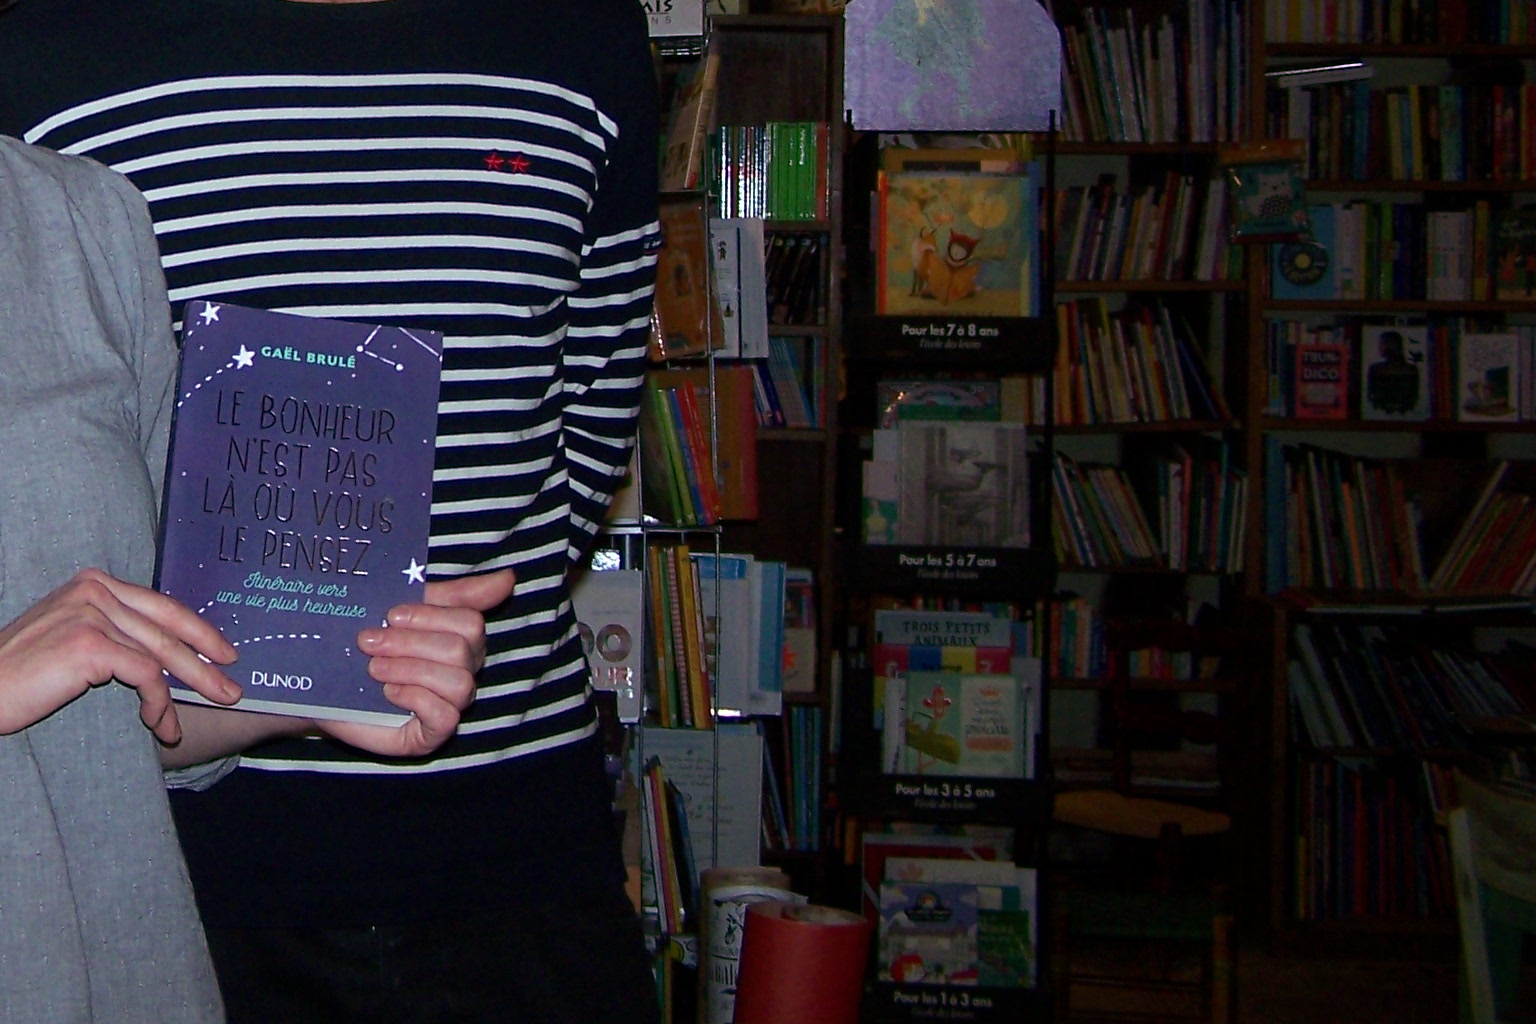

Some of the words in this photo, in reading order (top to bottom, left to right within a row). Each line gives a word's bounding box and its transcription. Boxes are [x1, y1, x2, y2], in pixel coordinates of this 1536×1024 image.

[901, 324, 927, 337] Pour
[929, 324, 945, 337] les
[946, 324, 956, 337] 7
[979, 327, 999, 337] ans
[260, 344, 303, 363] GAËL
[307, 350, 357, 369] BRULÉ
[216, 389, 245, 428] LE
[260, 395, 395, 445] BONHEUR
[226, 435, 311, 481] N'EST
[325, 446, 378, 487] PAS
[203, 474, 236, 517] LÀ
[253, 483, 296, 523] OÙ
[312, 489, 395, 534] VOUS
[219, 526, 247, 564] LE
[264, 529, 372, 576] PENSEZ
[899, 554, 925, 566] Pour
[927, 554, 942, 566] les
[977, 556, 996, 567] ans
[243, 571, 313, 597] Itinéraire
[318, 581, 348, 599] vers
[216, 589, 242, 605] une
[244, 591, 266, 608] vie
[266, 593, 299, 613] plus
[301, 599, 368, 618] heureuse
[251, 670, 313, 691] DUNOD
[895, 783, 921, 796] Pour
[975, 787, 996, 797] ans
